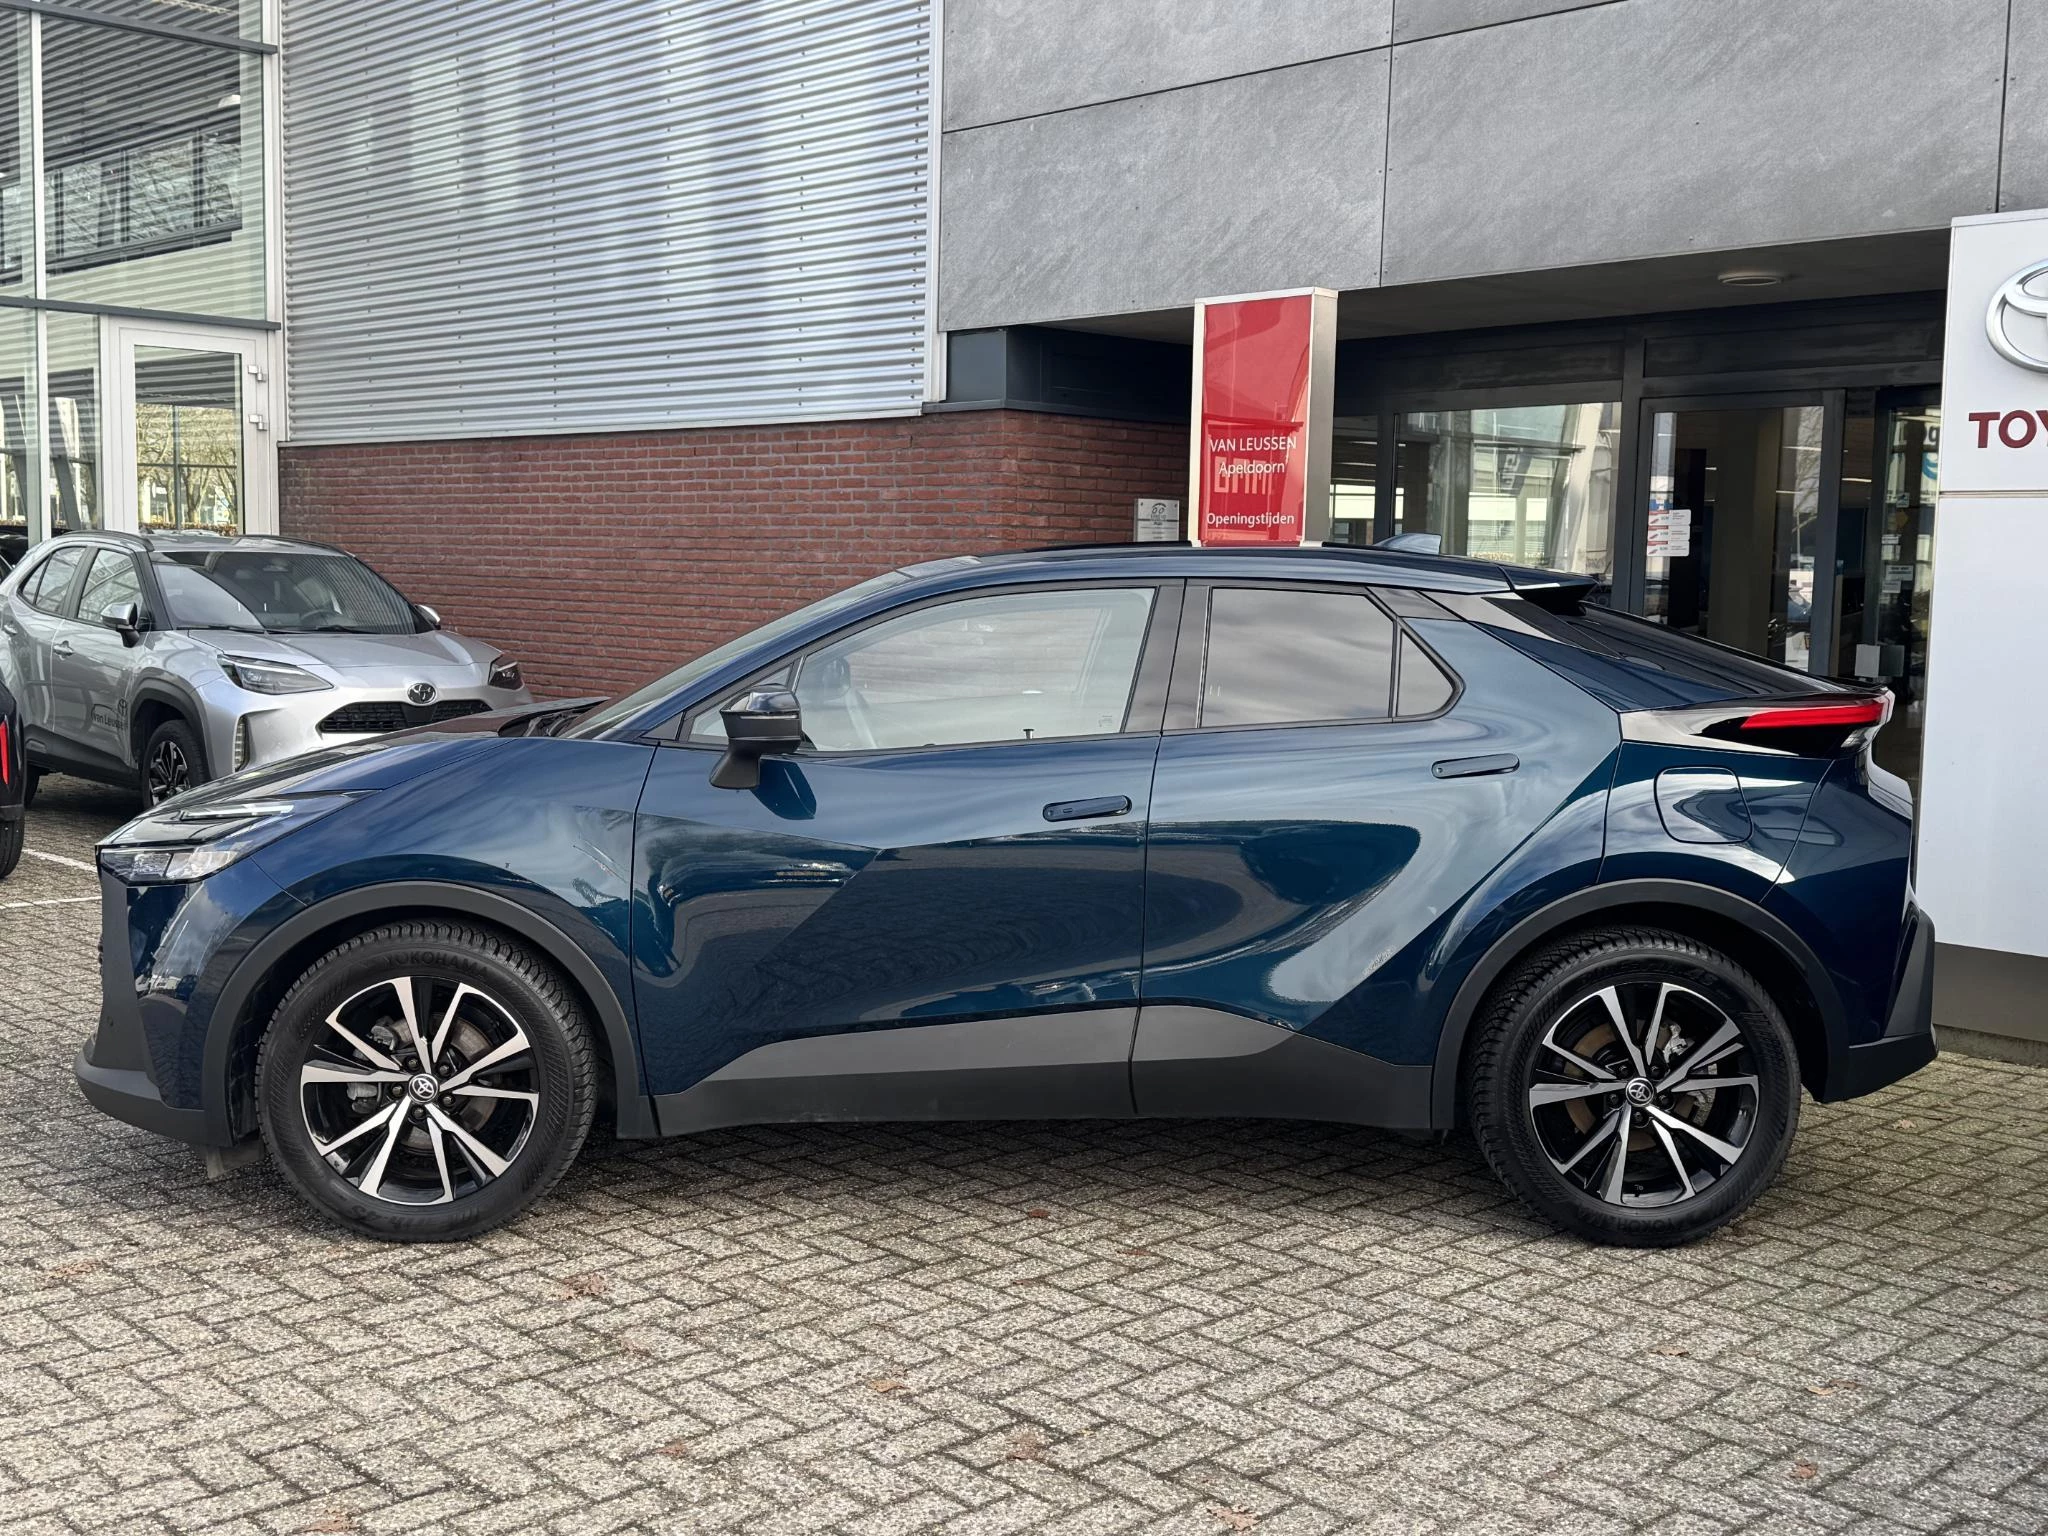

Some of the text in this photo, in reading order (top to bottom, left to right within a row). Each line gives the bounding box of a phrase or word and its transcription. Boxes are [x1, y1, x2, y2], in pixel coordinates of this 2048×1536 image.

[1210, 436, 1297, 452] VAN LEUSSEN
[1218, 461, 1285, 477] Apeldoorn
[1207, 512, 1294, 528] Openingstijden
